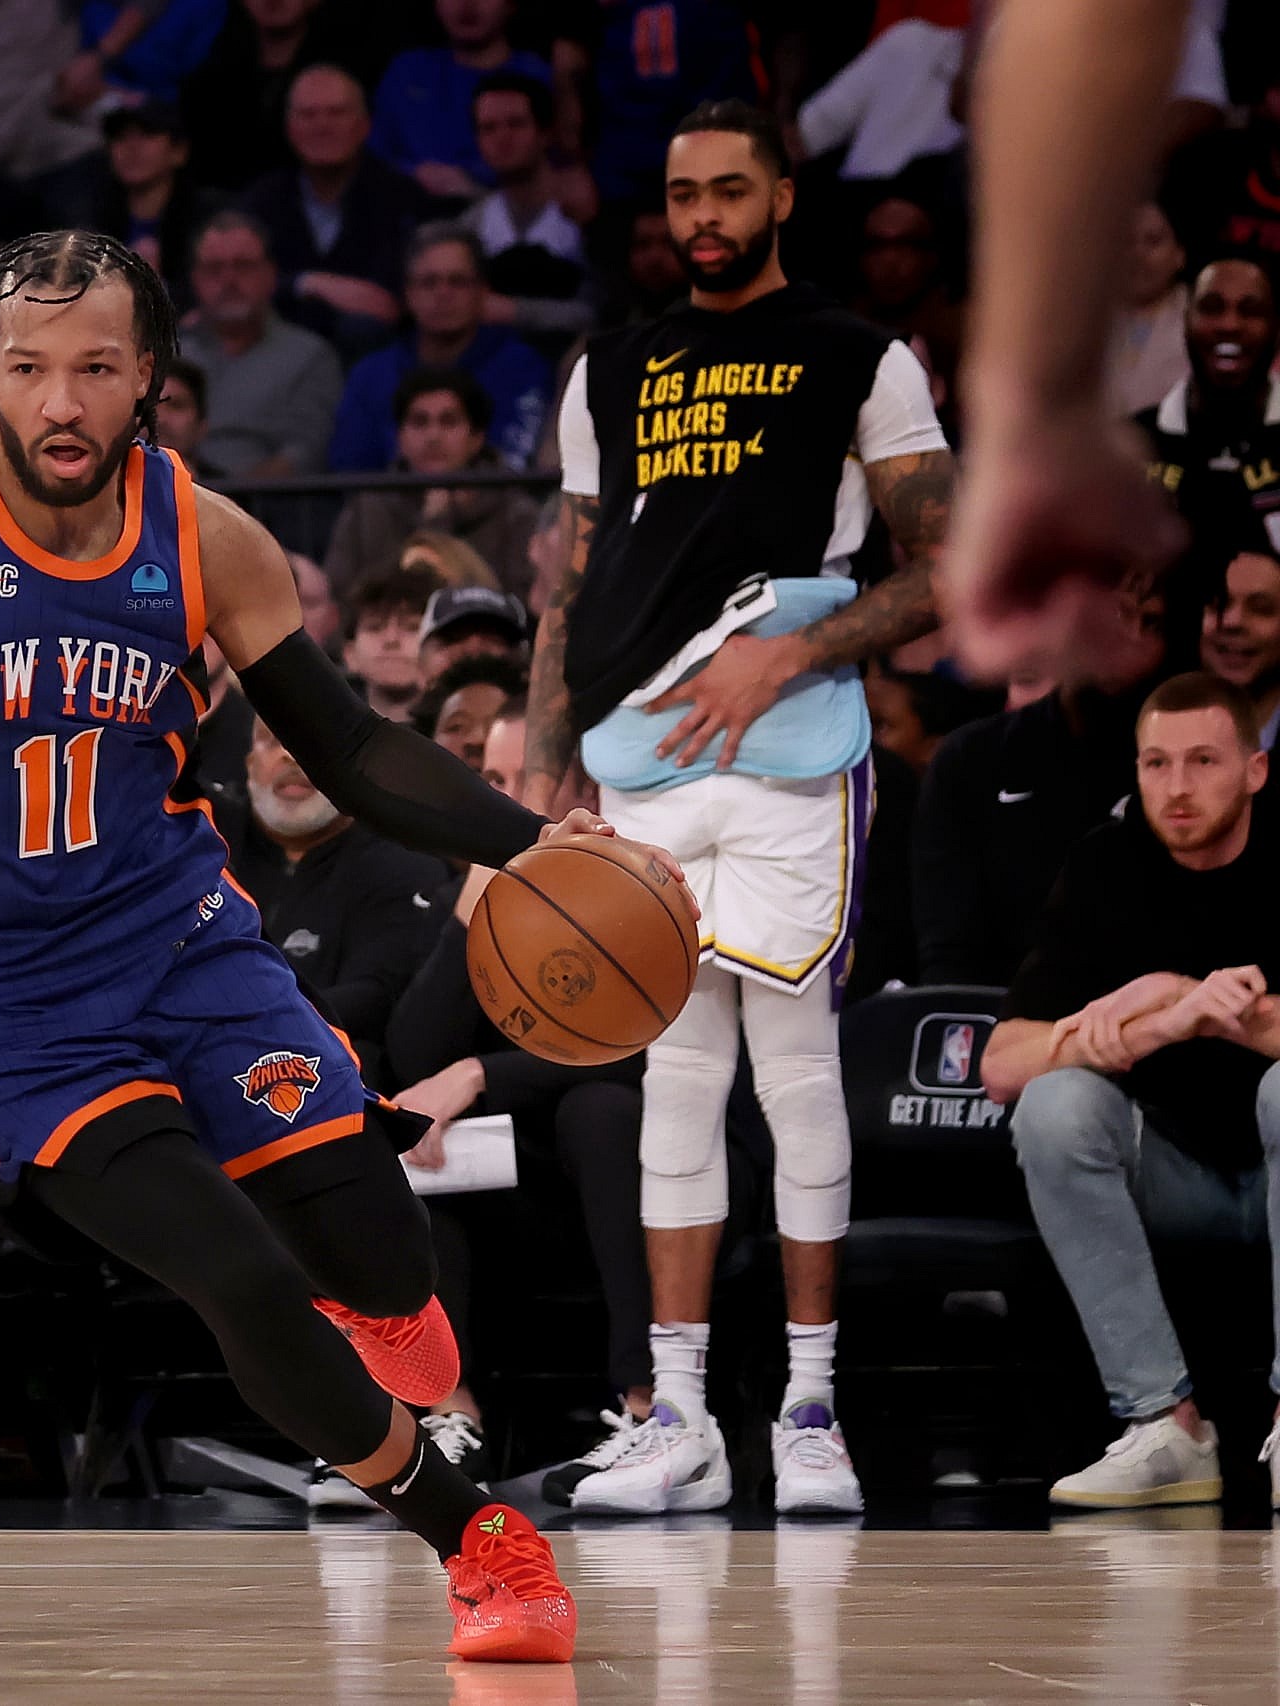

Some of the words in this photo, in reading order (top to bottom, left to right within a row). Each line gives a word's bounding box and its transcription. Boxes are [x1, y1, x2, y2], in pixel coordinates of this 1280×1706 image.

[639, 372, 685, 409] LOS
[692, 363, 803, 399] ANGELES
[636, 401, 727, 448] LAKERS
[126, 597, 175, 611] sphere
[14, 728, 104, 858] 11
[247, 1057, 317, 1097] KNICKS
[889, 1095, 927, 1124] GET
[930, 1097, 966, 1127] THE
[966, 1098, 1005, 1128] APP
